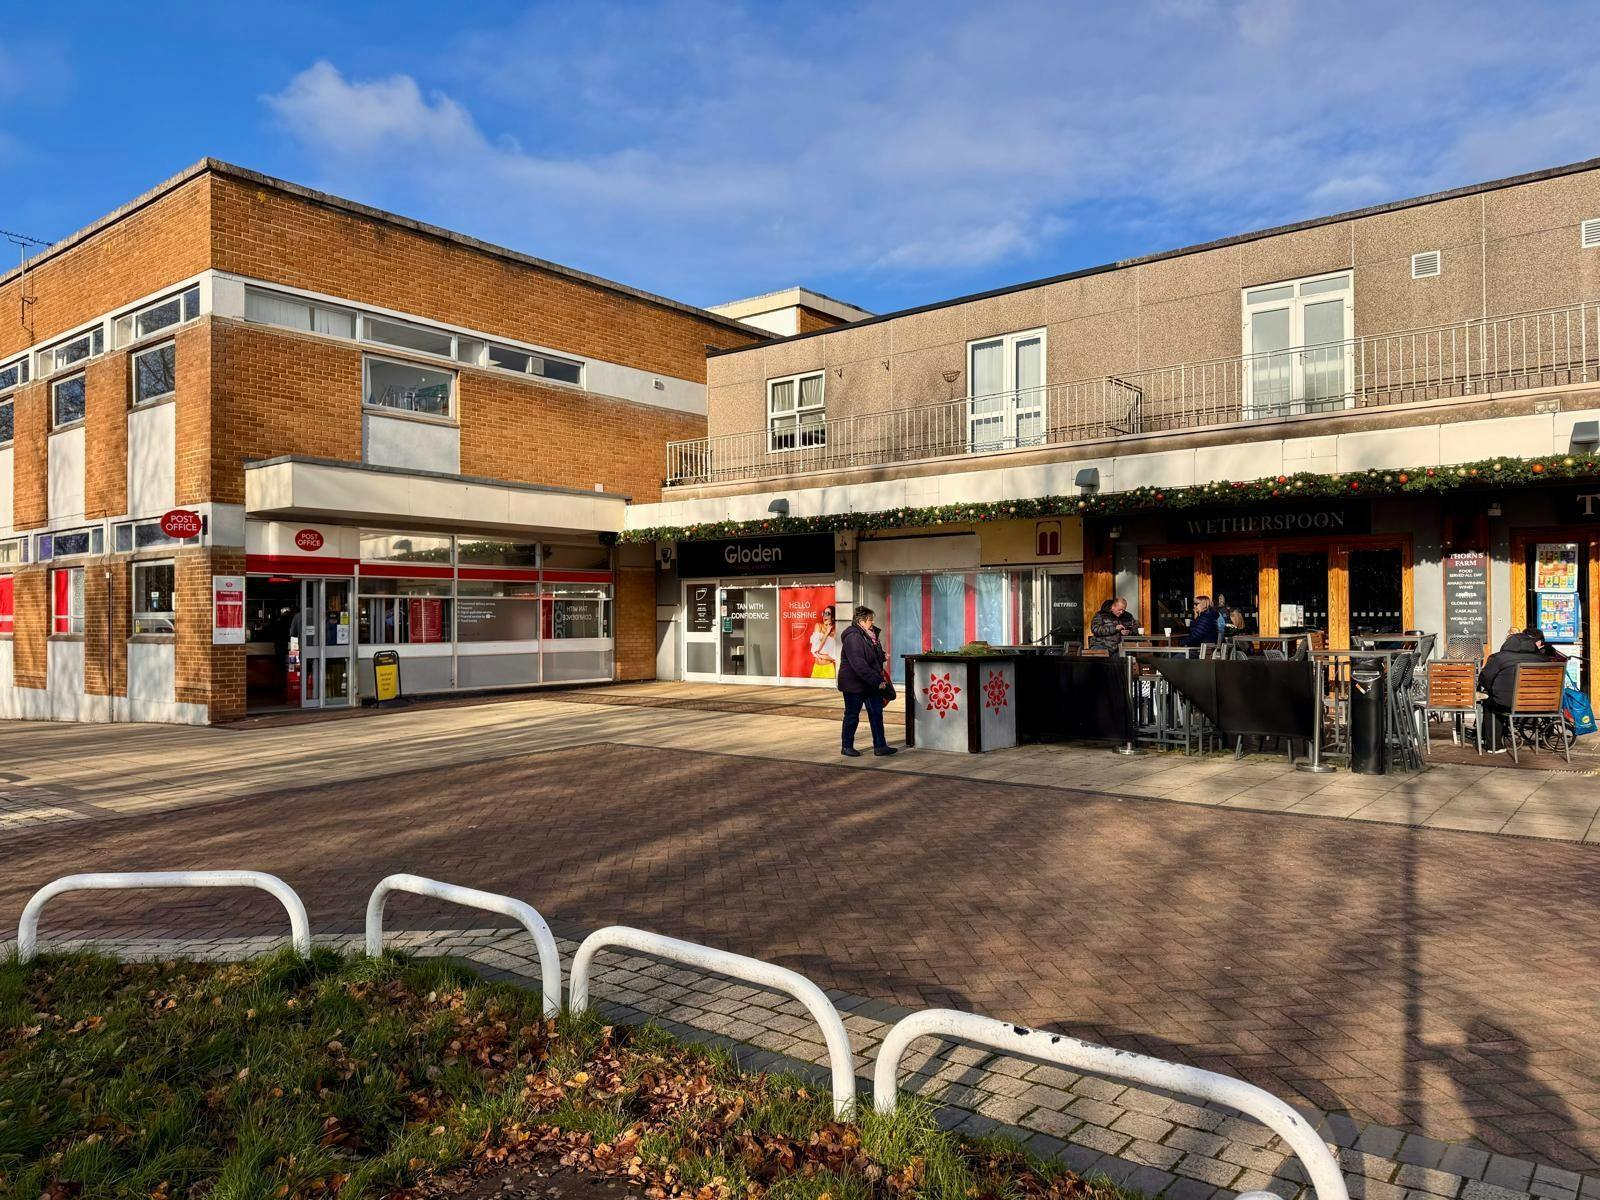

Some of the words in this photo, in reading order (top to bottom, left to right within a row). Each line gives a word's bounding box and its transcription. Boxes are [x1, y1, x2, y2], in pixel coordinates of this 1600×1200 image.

[170, 515, 194, 524] POST
[1187, 511, 1345, 535] WETHERSPOON
[165, 523, 197, 532] OFFICE
[301, 533, 318, 541] POST
[298, 539, 321, 547] OFFICE
[724, 544, 782, 563] Gloden
[748, 602, 764, 610] WITH
[789, 601, 811, 609] HELLO
[731, 612, 769, 620] CONFIDENCE
[782, 611, 817, 619] SUNSHINE
